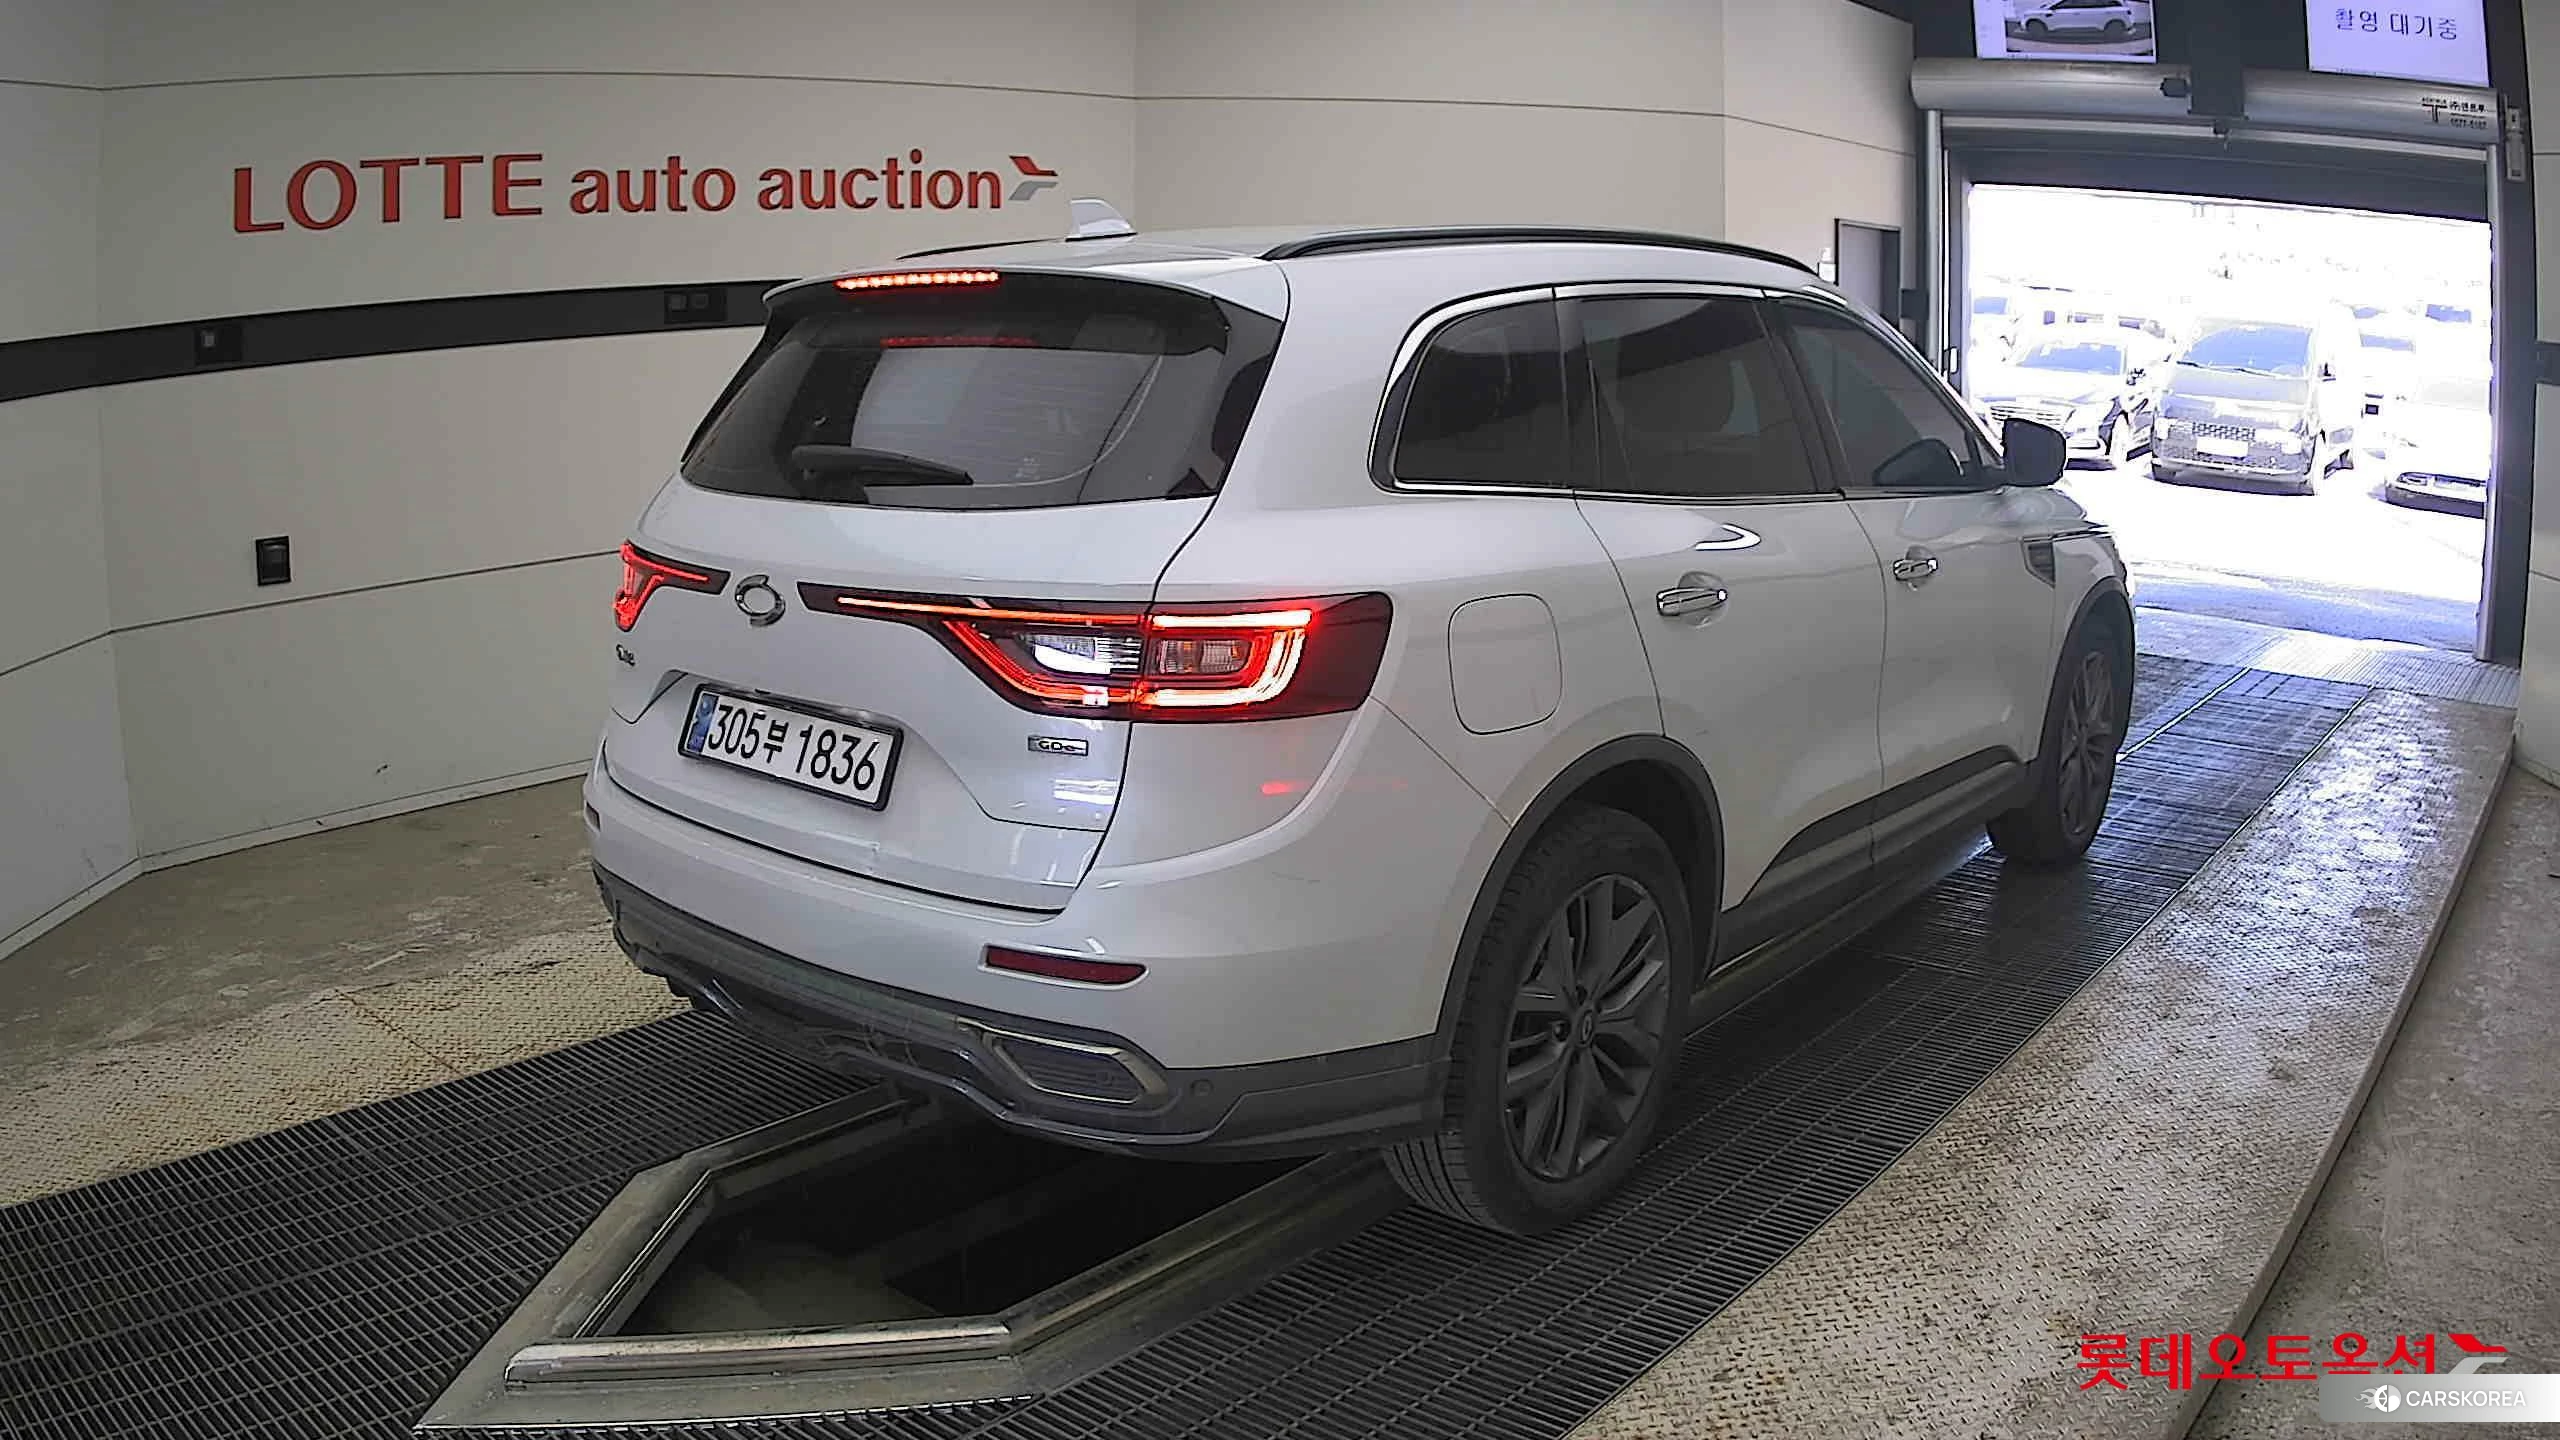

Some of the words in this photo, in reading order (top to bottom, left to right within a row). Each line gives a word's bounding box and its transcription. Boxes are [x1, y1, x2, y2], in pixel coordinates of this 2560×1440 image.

[2336, 8, 2378, 33] 촬영
[2389, 13, 2457, 41] 대기중
[233, 153, 544, 234] LOTTE
[569, 155, 737, 215] auto
[757, 149, 1002, 211] auction
[707, 703, 790, 764] 305부
[795, 724, 880, 791] 1836
